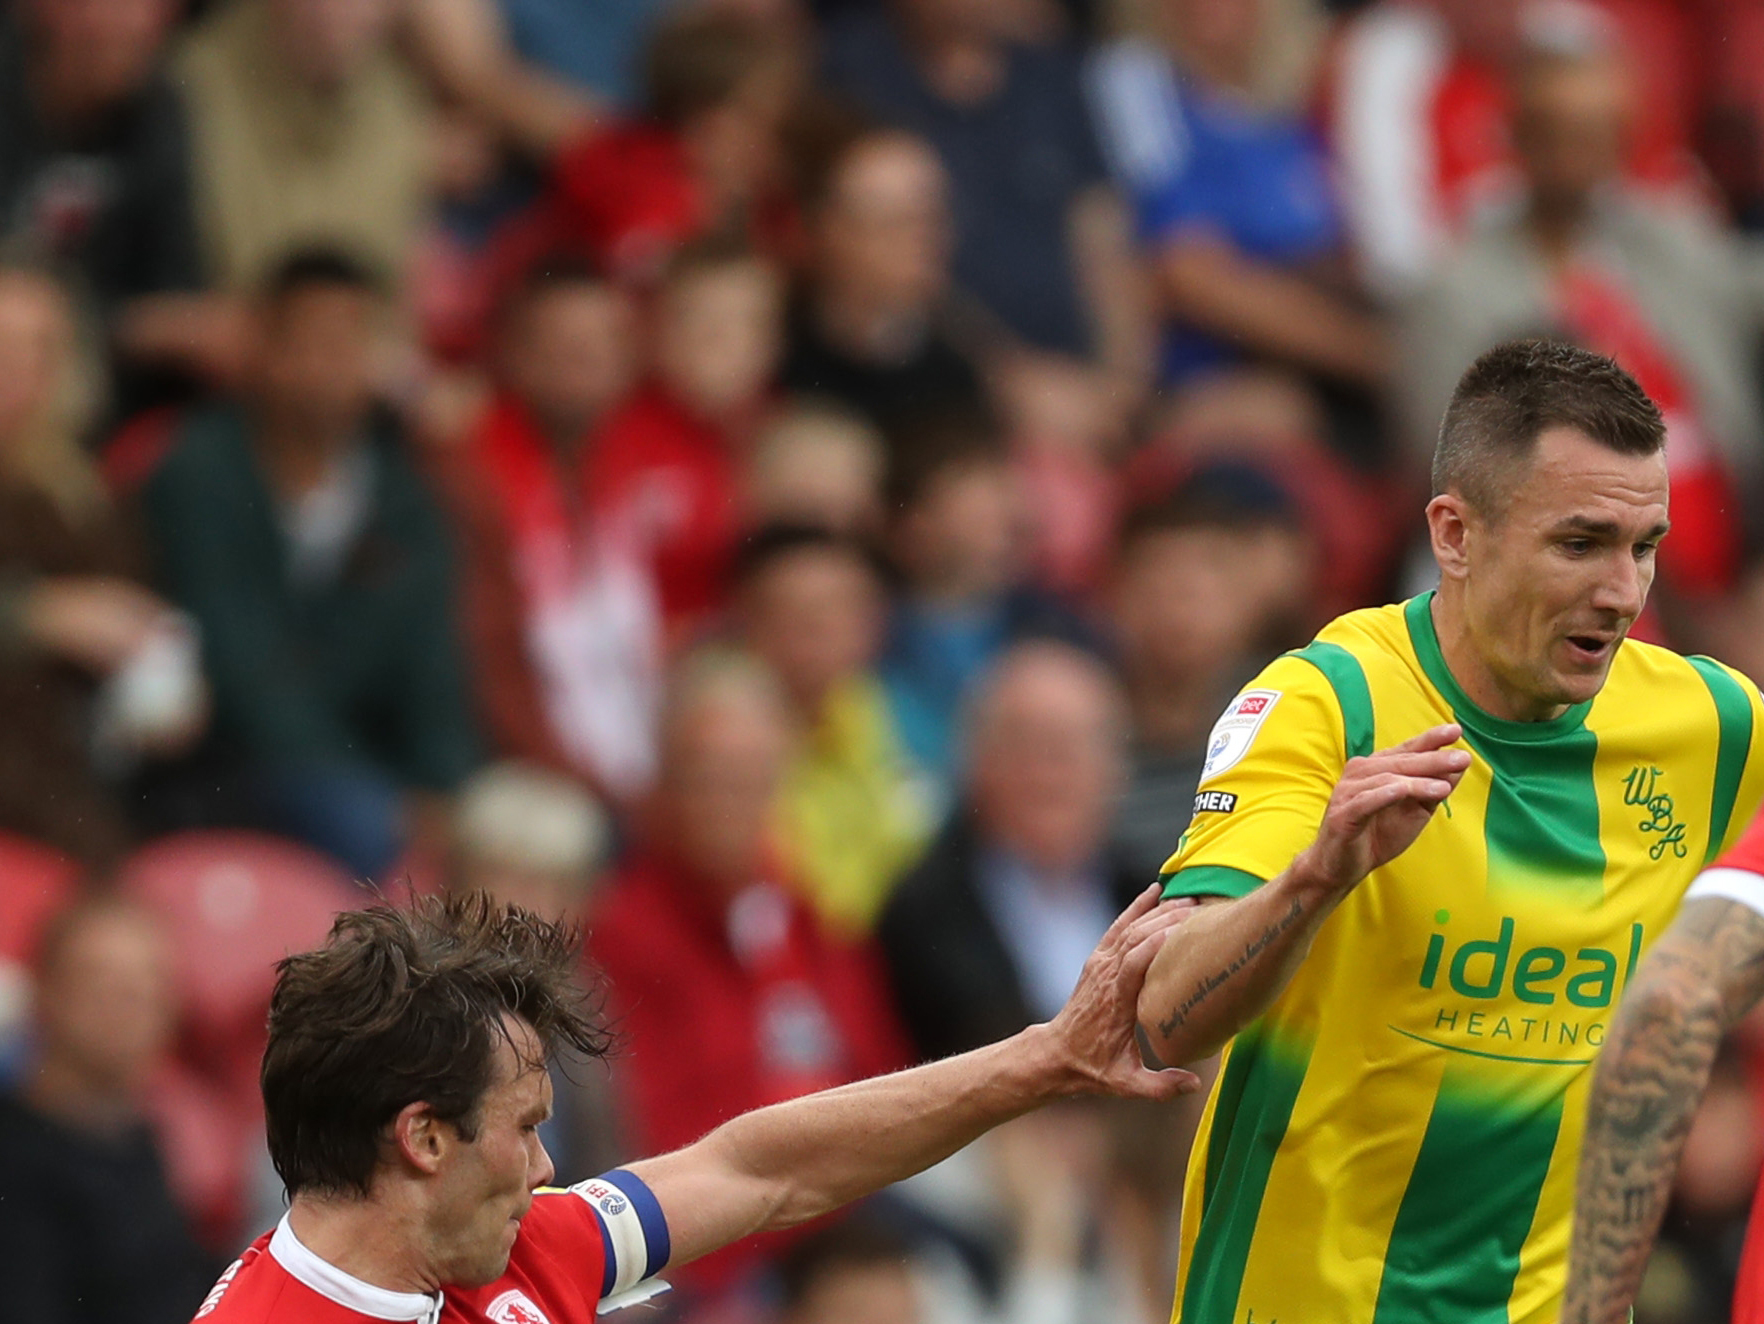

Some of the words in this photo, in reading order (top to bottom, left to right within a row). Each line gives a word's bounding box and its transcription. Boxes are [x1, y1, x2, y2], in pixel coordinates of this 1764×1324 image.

[1621, 765, 1688, 861] WBA
[1419, 908, 1644, 1009] ideal
[1434, 1008, 1605, 1047] HEATING
